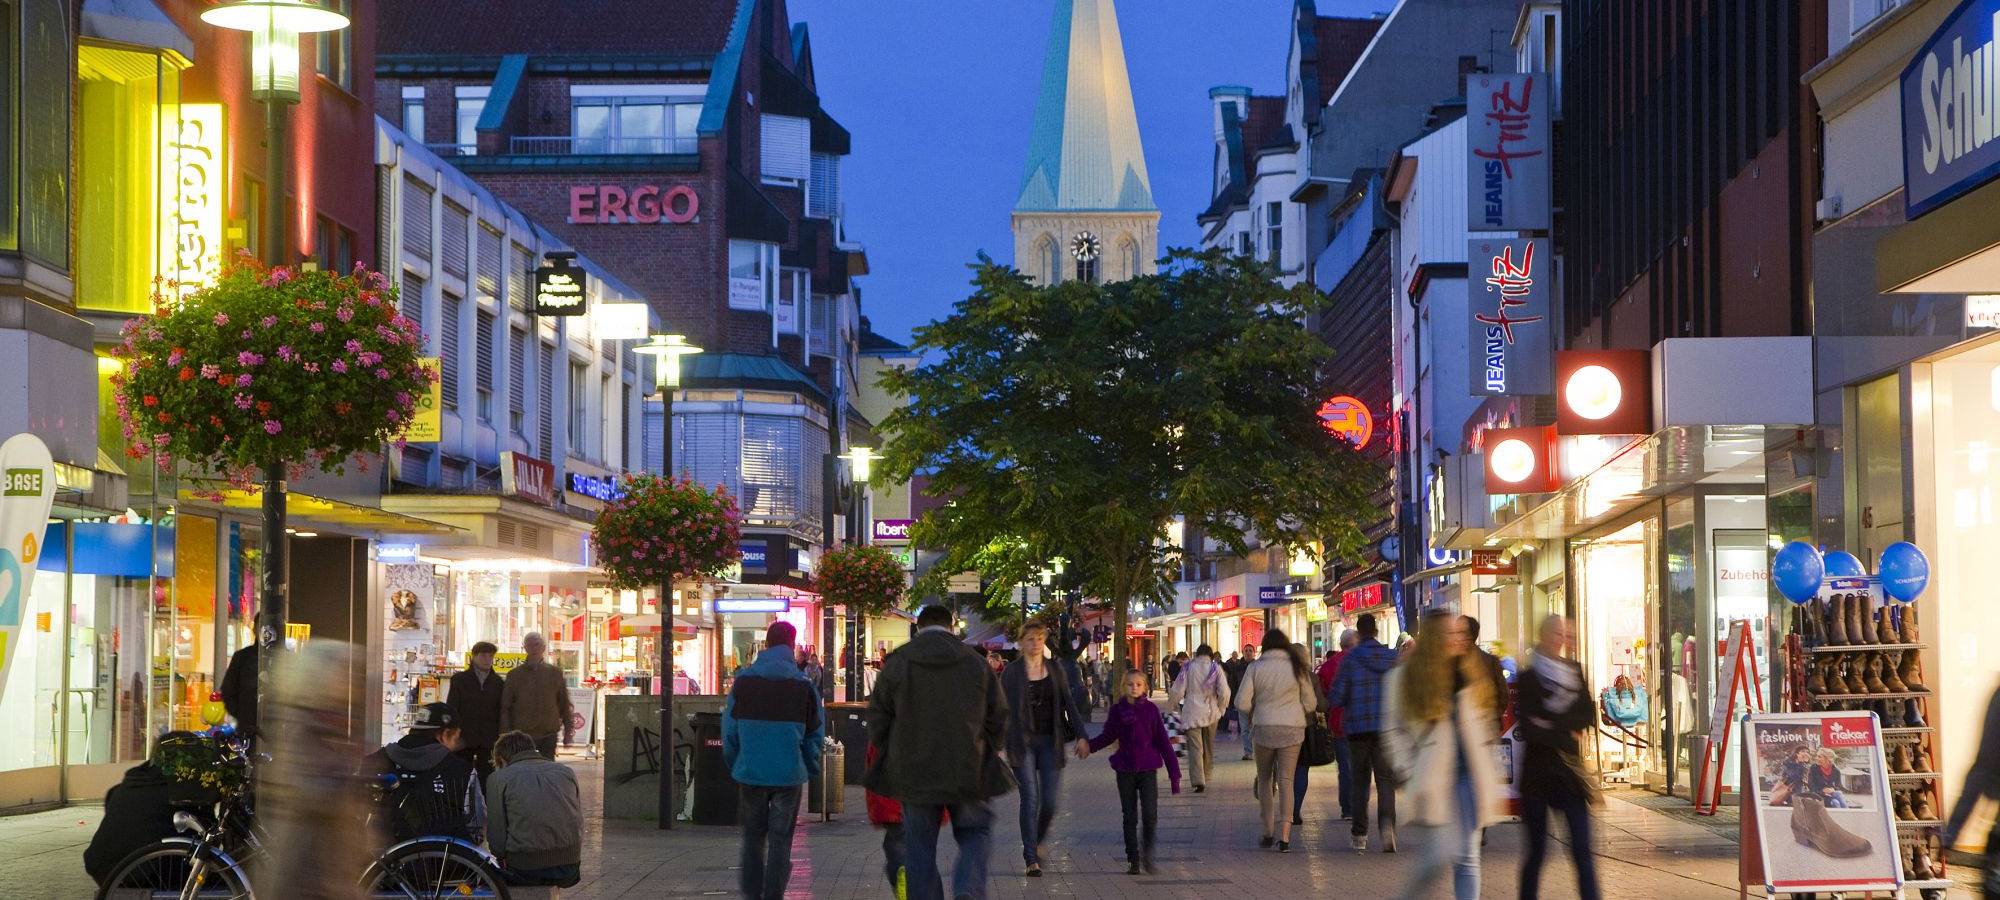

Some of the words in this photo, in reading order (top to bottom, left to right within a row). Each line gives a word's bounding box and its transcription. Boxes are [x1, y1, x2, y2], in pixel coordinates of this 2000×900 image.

[1474, 76, 1542, 179] fritz
[570, 185, 699, 223] ERGO
[1485, 160, 1503, 226] JEANS
[1475, 241, 1543, 344] fritz
[1486, 326, 1505, 393] JEANS
[4, 474, 40, 491] BASE
[515, 460, 544, 496] JILLY
[1720, 568, 1768, 580] Zubehö
[688, 591, 700, 600] DSL
[1760, 728, 1803, 744] fashion
[1806, 728, 1821, 746] by
[1830, 729, 1869, 740] rieker
